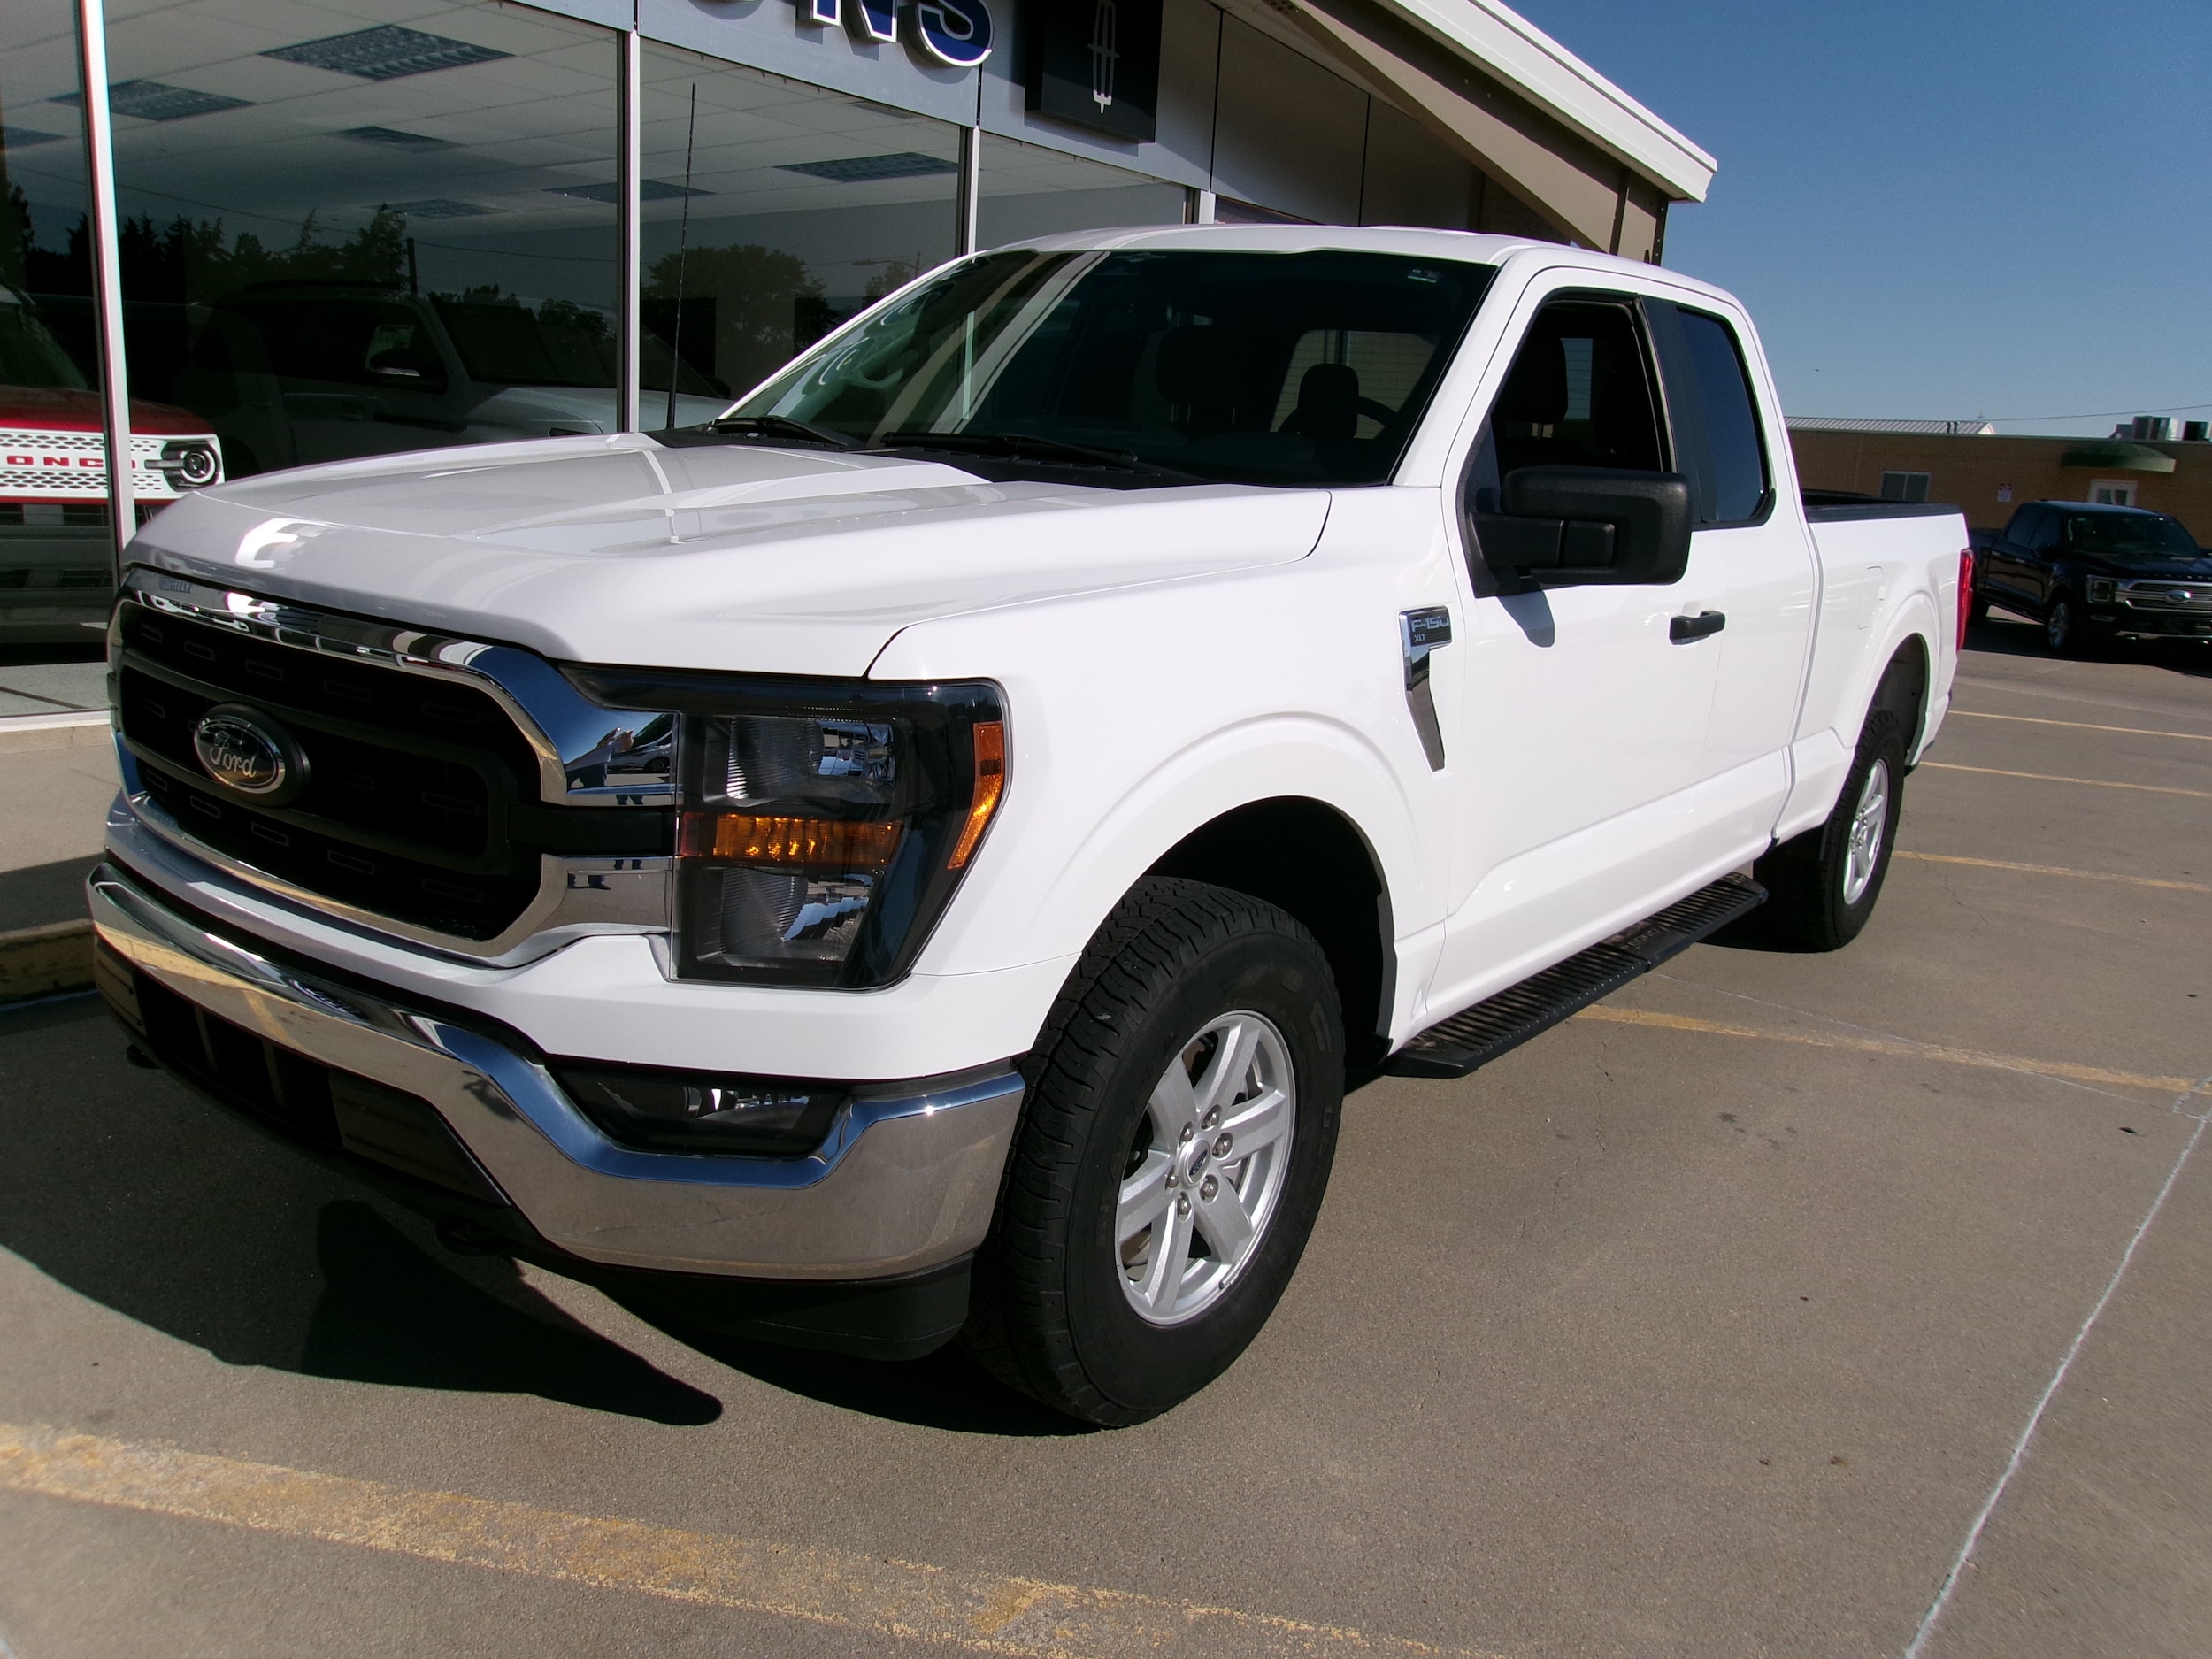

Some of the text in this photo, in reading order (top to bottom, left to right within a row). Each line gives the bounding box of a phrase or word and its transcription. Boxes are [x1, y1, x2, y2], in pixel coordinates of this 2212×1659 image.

[7, 455, 135, 469] ONC
[1411, 615, 1449, 632] F-150
[1414, 634, 1425, 642] XLT
[210, 733, 257, 778] Ford
